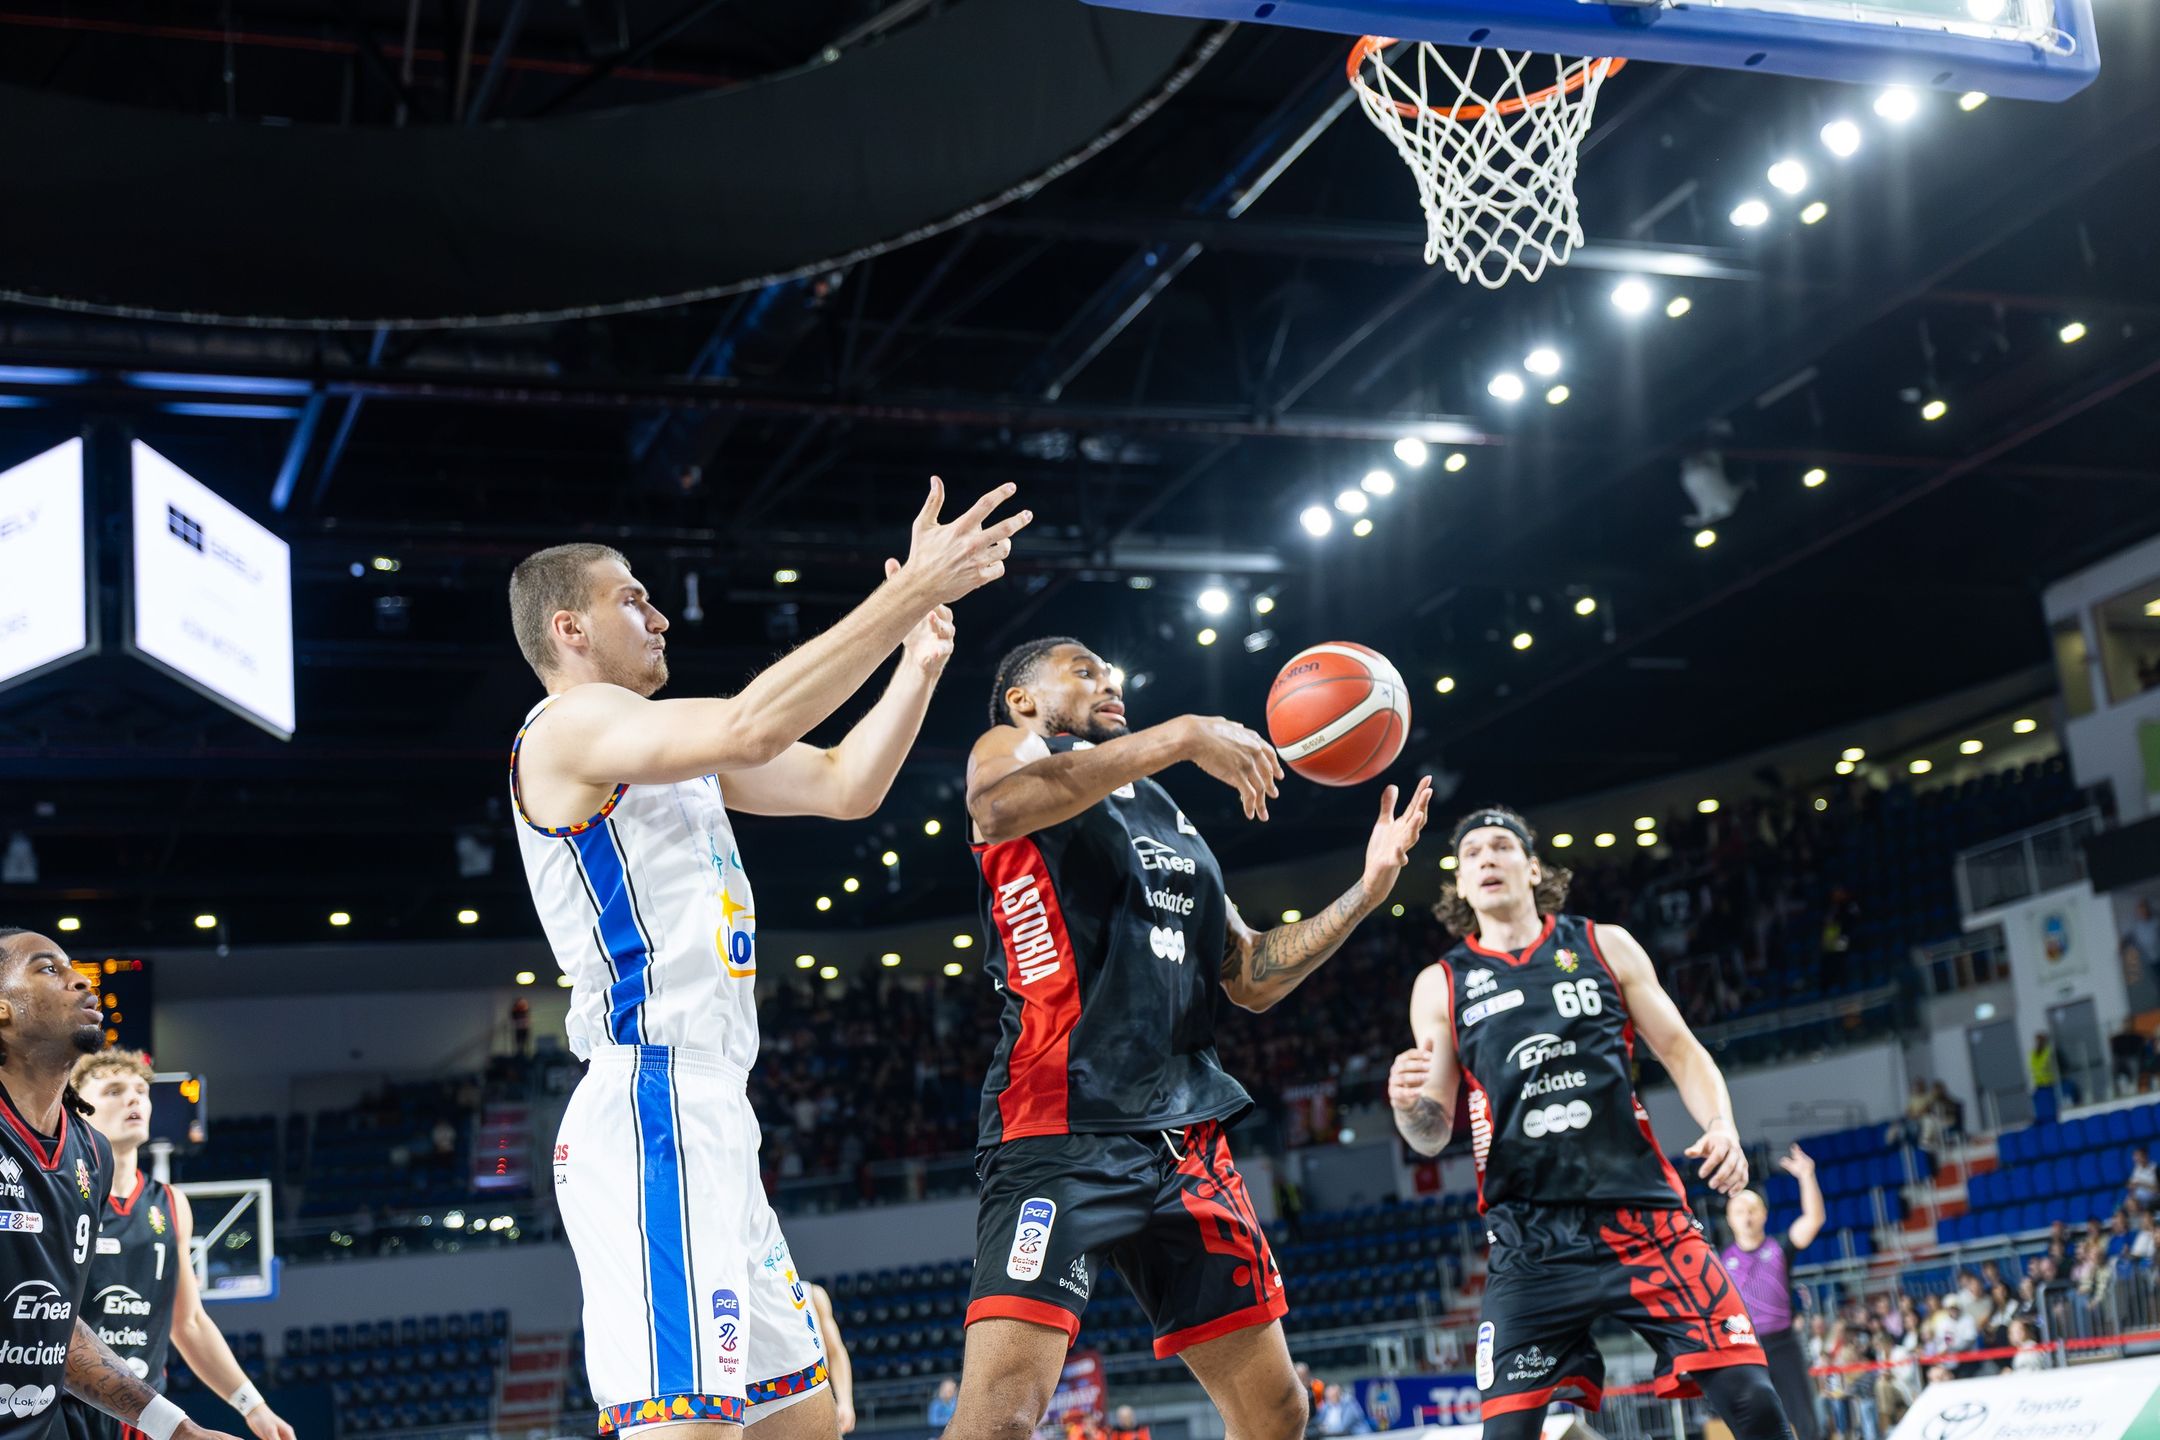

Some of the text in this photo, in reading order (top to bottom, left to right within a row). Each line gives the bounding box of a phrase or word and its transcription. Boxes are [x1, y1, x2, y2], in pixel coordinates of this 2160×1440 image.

[1138, 849, 1196, 875] Enea
[998, 874, 1060, 986] ASTORIA
[1552, 977, 1602, 1018] 66
[1518, 1040, 1576, 1070] Enea
[1025, 1207, 1050, 1219] PGE
[73, 1214, 91, 1264] 9
[154, 1243, 166, 1280] 1
[1012, 1255, 1039, 1266] Basket
[1015, 1264, 1032, 1274] Liga
[13, 1295, 72, 1320] Enea
[103, 1295, 151, 1316] Enea
[716, 1298, 738, 1309] PGE
[718, 1355, 740, 1365] Basket
[723, 1365, 736, 1375] Liga
